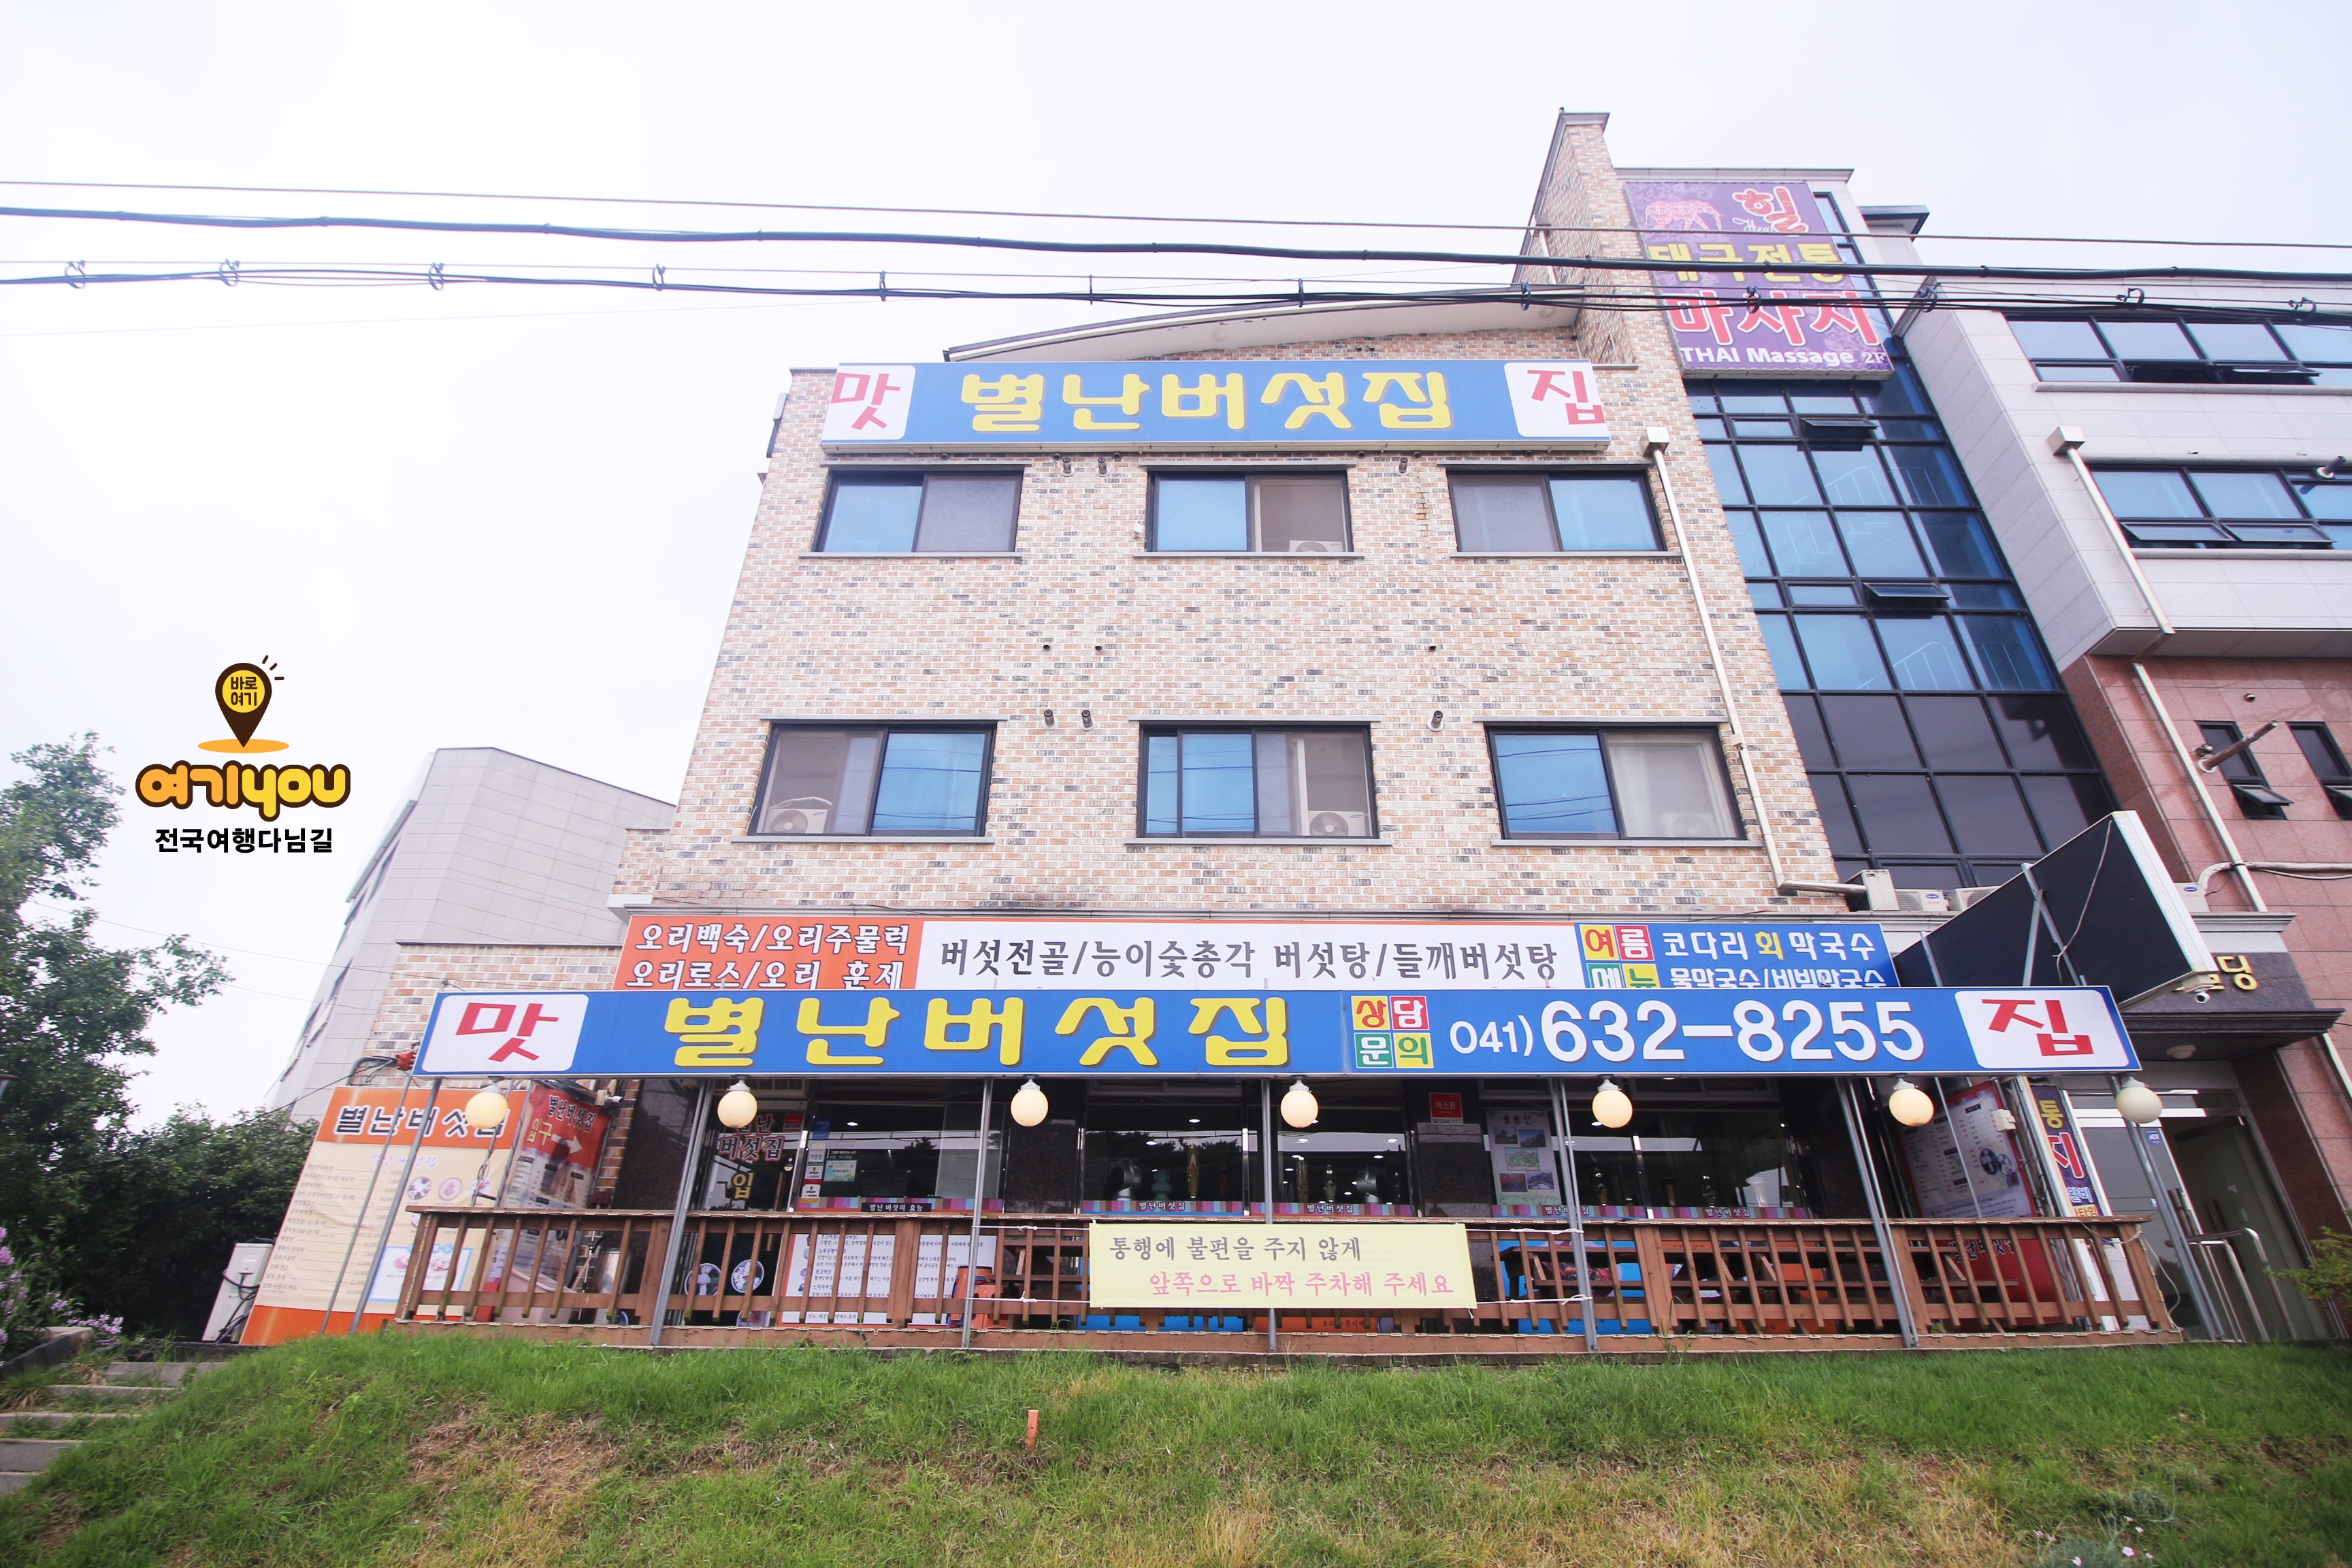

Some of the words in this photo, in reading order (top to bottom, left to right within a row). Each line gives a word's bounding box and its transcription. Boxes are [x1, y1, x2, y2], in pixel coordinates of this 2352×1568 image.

[1732, 186, 1809, 237] 힐
[1648, 243, 1847, 283] 대구전통
[1665, 290, 1881, 346] 마사지
[1680, 348, 1740, 362] THAI
[1746, 348, 1855, 367] Massage
[1861, 352, 1888, 364] 2F
[830, 372, 901, 430] 맛
[960, 372, 1452, 432] 별난버섯집
[1527, 369, 1605, 425] 집
[635, 923, 909, 955] 오리백숙/오리주물럭
[1585, 928, 1649, 958] 여름
[1662, 931, 1749, 960] 코다리
[1755, 931, 1784, 960] 회
[1788, 932, 1876, 961] 막국수
[941, 939, 1256, 979] 버섯전골/능이숯총각
[1273, 942, 1557, 980] 버섯탕/들깨버섯탕
[625, 960, 821, 990] 오리로스/오리
[842, 960, 904, 990] 훈제
[1356, 1000, 1424, 1028] 상담
[455, 1002, 559, 1062] 맛
[664, 996, 1288, 1068] 별난버섯집
[1981, 999, 2094, 1057] 집
[1360, 1036, 1429, 1066] 문의
[336, 1106, 509, 1138] 별난버섯
[548, 1095, 597, 1132] 별난버섯집
[527, 1118, 553, 1146] 입구
[720, 1136, 784, 1161] 버섯집
[733, 1173, 754, 1198] 입
[1139, 1201, 1186, 1211] 별난버섯집
[1307, 1204, 1354, 1213] 별난버섯집
[1705, 1208, 1750, 1217] 별난버섯집
[1109, 1237, 1175, 1261] 통행에
[1186, 1237, 1255, 1261] 불편을
[1263, 1237, 1307, 1261] 주지
[1318, 1237, 1361, 1262] 않게
[1149, 1271, 1242, 1296] 앞쪽으로
[1251, 1271, 1296, 1297] 바짝
[1305, 1271, 1372, 1297] 주차해
[1383, 1272, 1454, 1297] 주세요
